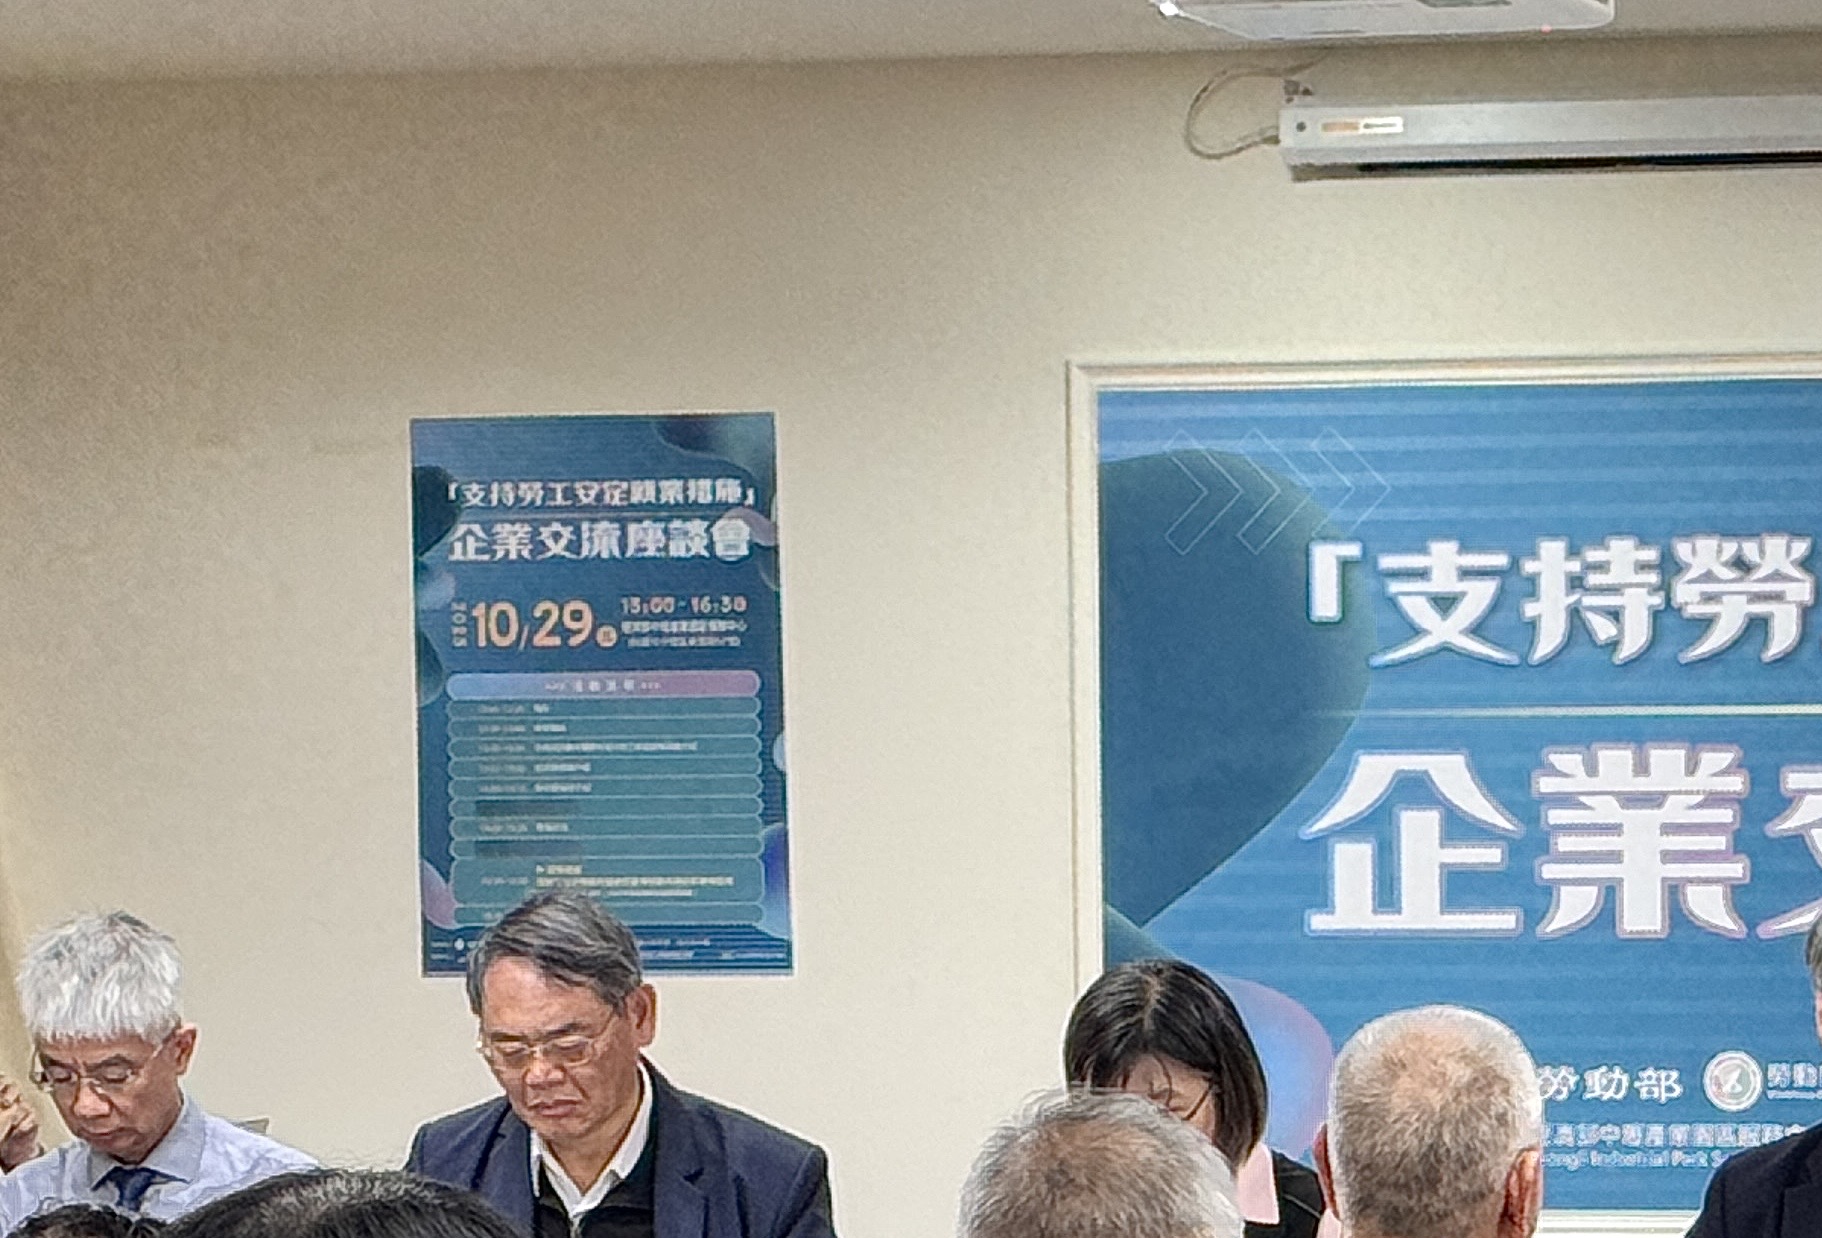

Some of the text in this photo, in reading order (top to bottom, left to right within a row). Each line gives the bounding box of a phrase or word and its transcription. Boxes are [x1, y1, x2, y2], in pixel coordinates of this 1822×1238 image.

[448, 518, 751, 562] 企業交流座談會
[472, 600, 593, 651] 10/29
